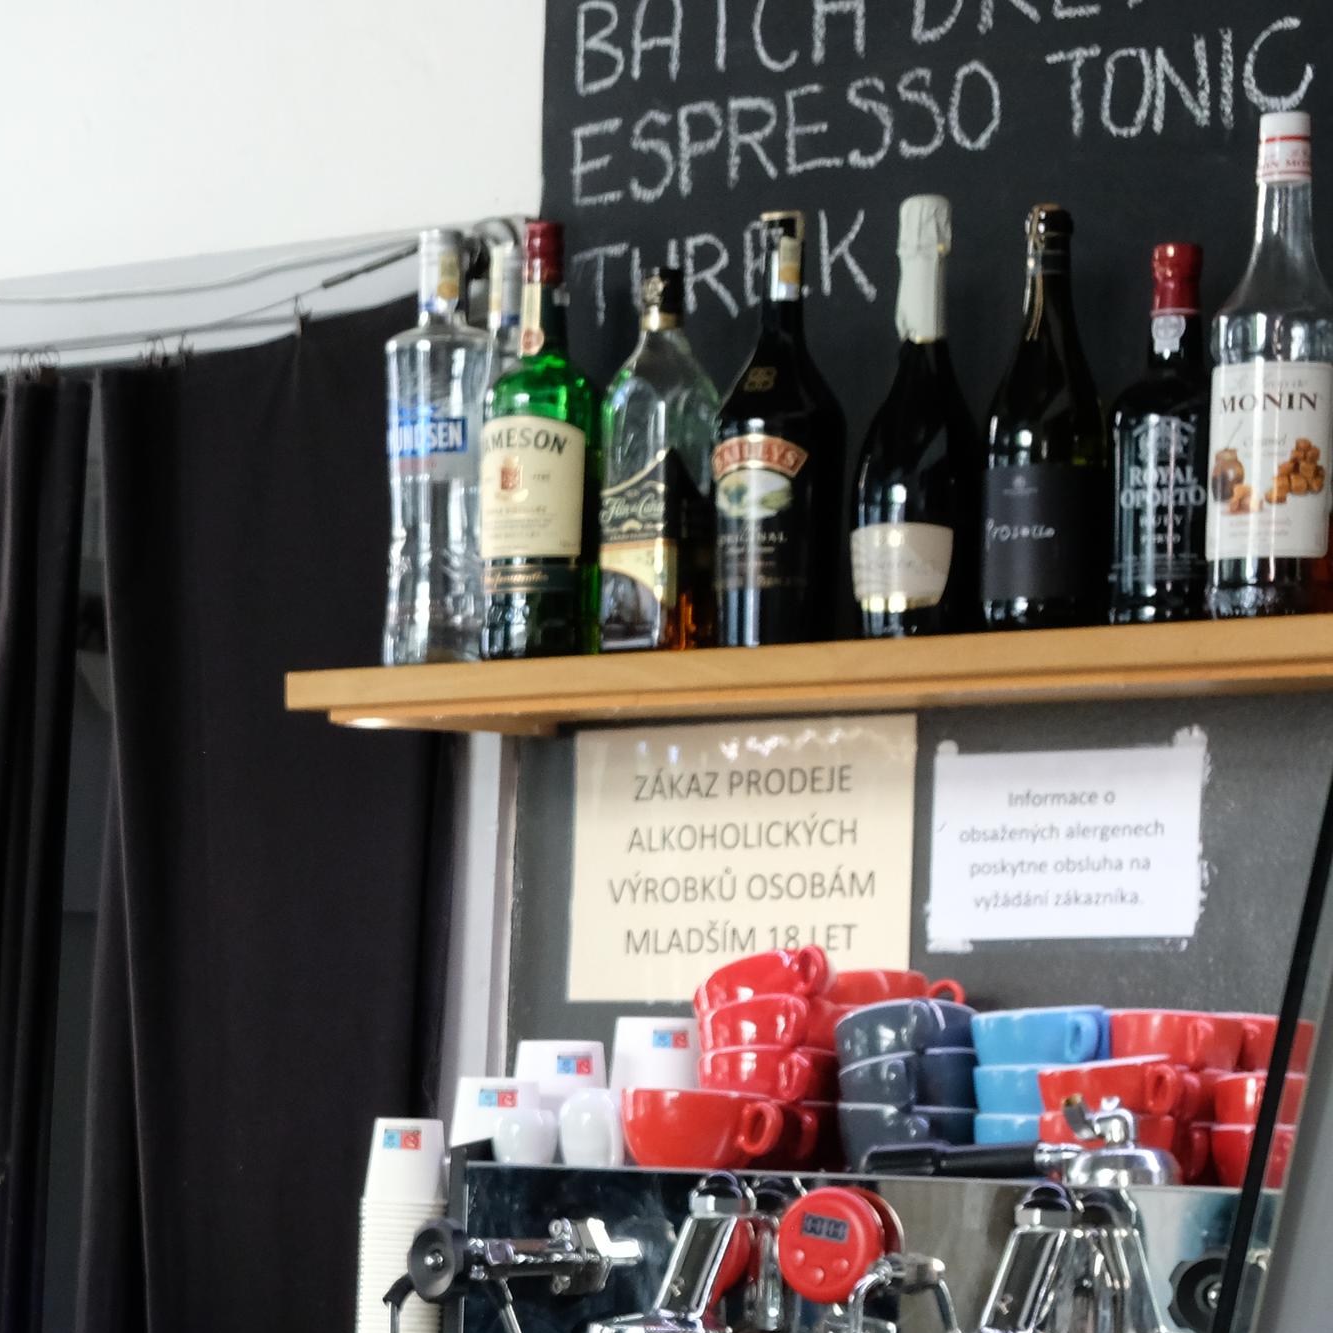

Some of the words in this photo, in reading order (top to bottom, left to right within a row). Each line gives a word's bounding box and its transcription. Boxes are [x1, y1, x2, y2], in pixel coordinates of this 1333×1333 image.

[571, 59, 1000, 206] ESPRESSO
[1045, 15, 1314, 138] TONIC
[1220, 391, 1319, 414] MONIN
[485, 427, 568, 456] AMESON
[1129, 465, 1199, 487] ROYAL
[1120, 485, 1208, 510] OPORTO
[634, 768, 720, 802] ZÁKAZ
[729, 764, 854, 797] PRODEJE
[1007, 788, 1099, 808] Informace
[1104, 790, 1116, 804] o
[627, 812, 858, 854] ALKOHOLICKÝCH
[959, 823, 1060, 845] obsažených
[1065, 819, 1166, 843] alergenech
[968, 857, 1047, 879] poskytne
[1054, 855, 1123, 875] obsluha
[1129, 857, 1151, 872] na
[608, 866, 737, 905] VÝROBKŮ
[746, 864, 876, 901] OSOBÁM
[973, 889, 1050, 912] vyžádání
[624, 919, 757, 955] MLADŠÍM
[769, 925, 799, 950] 18
